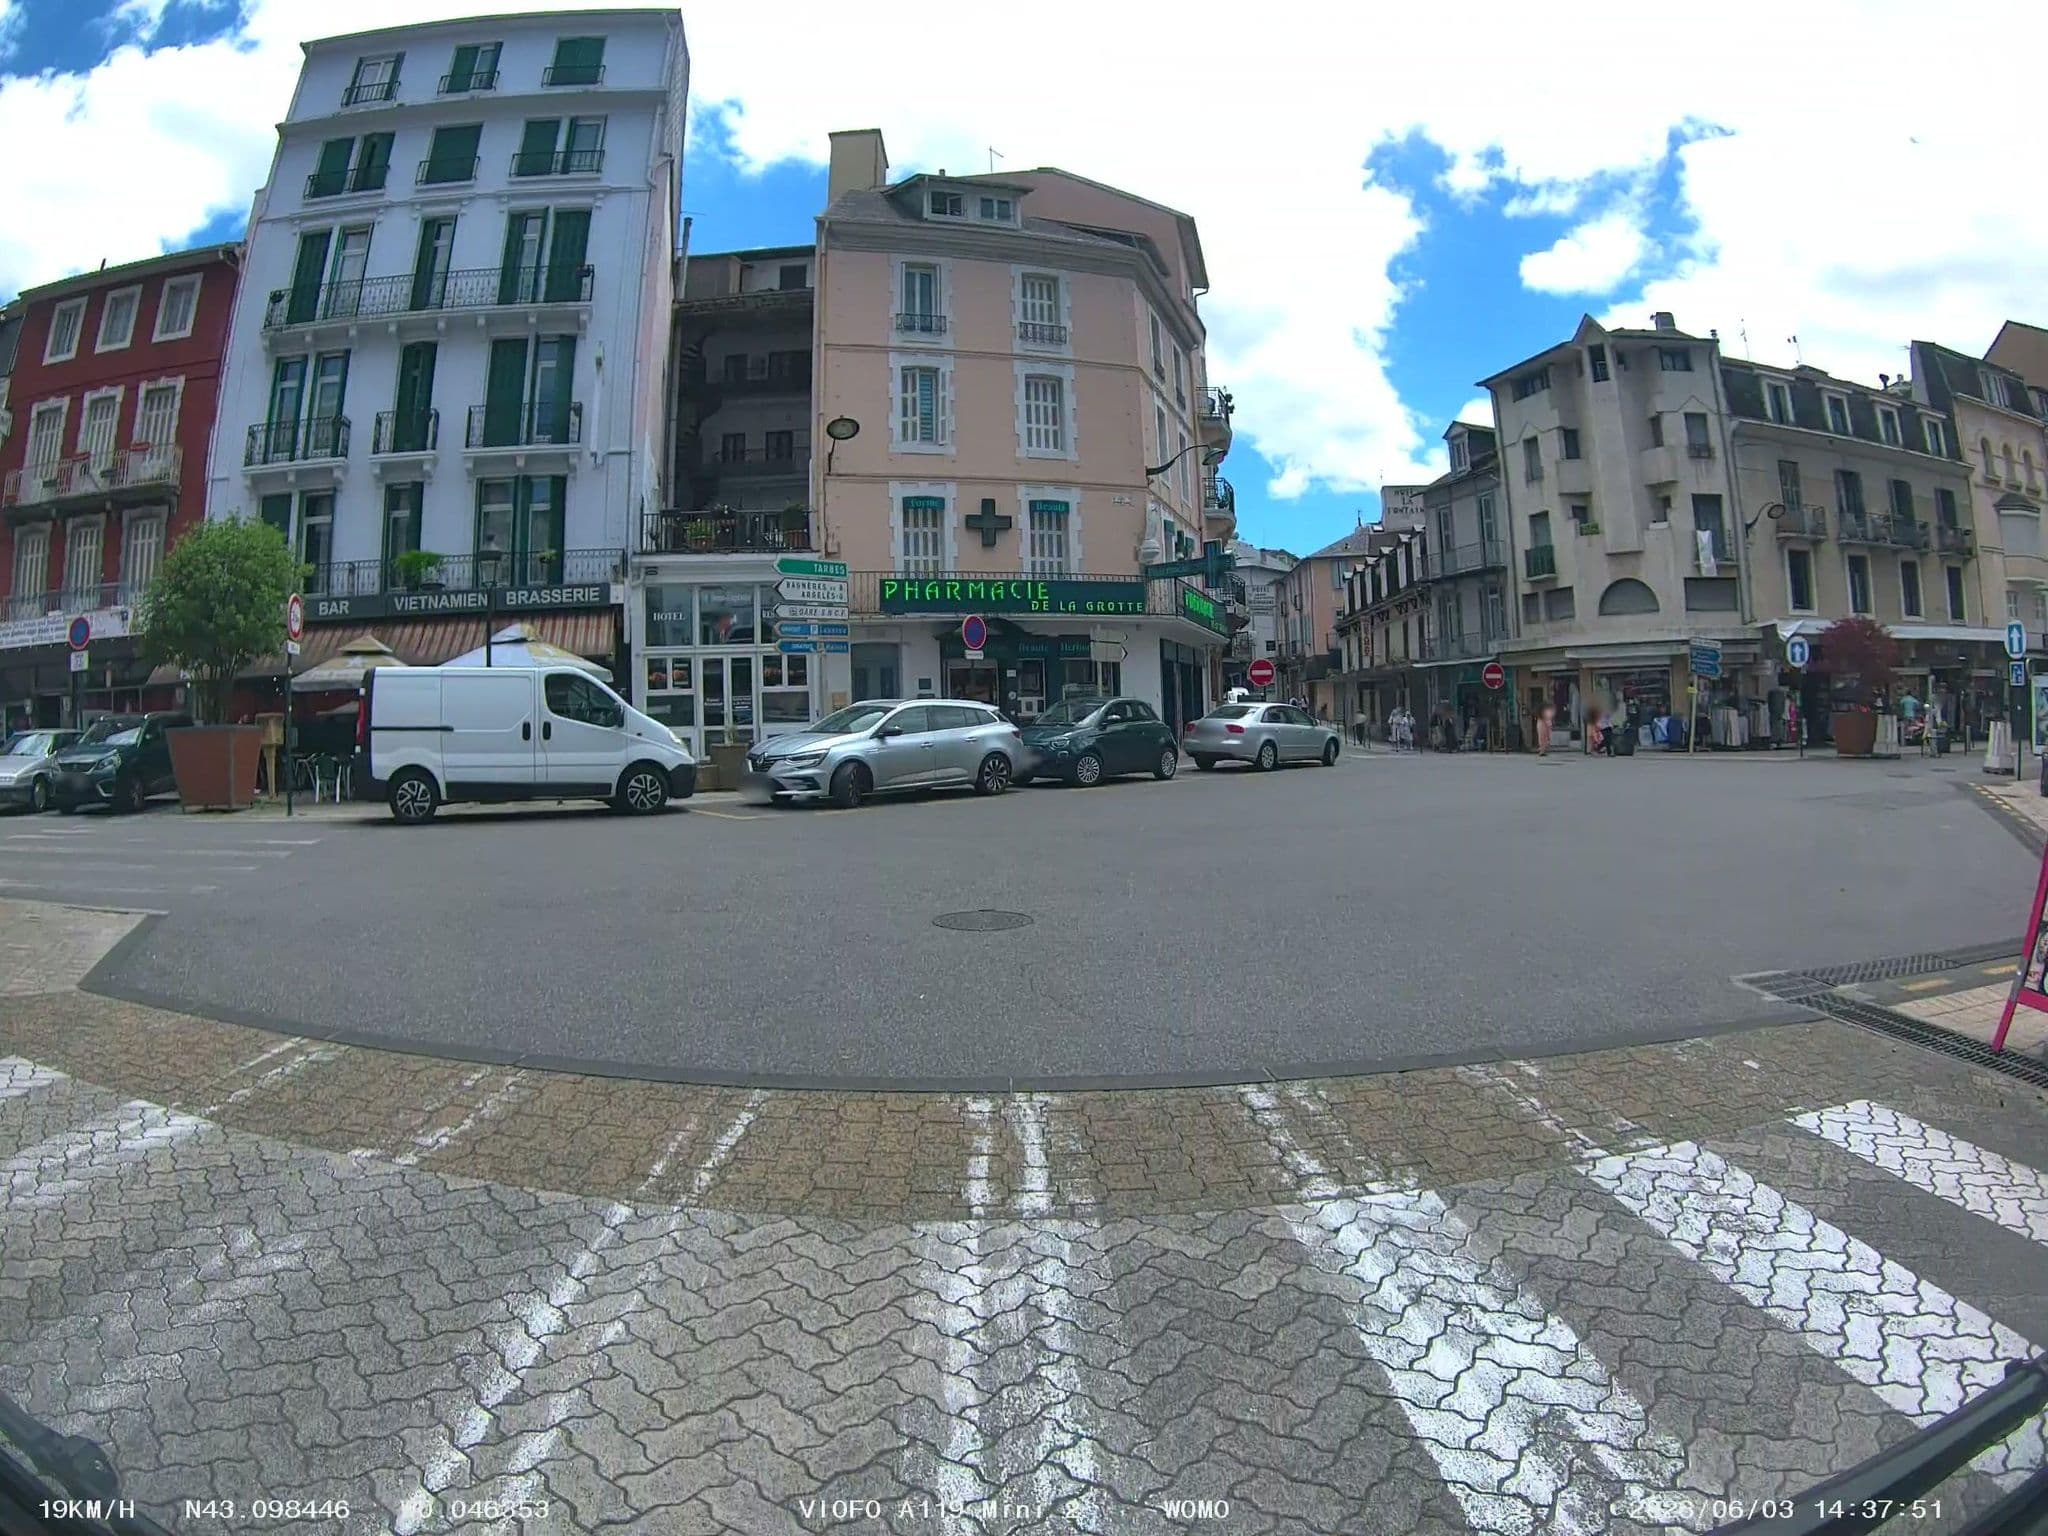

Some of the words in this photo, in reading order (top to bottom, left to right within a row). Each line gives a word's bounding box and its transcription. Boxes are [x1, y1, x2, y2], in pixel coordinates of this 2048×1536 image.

[814, 563, 845, 575] TARBES
[884, 581, 1050, 602] PHARMACIE
[319, 601, 350, 616] BAR
[393, 593, 489, 612] VIETNAMIEN
[506, 587, 600, 606] BRASSERIE
[1031, 601, 1051, 612] DE
[1060, 601, 1078, 612] LA
[1087, 601, 1145, 613] GROTTE
[653, 612, 686, 621] HOTEL
